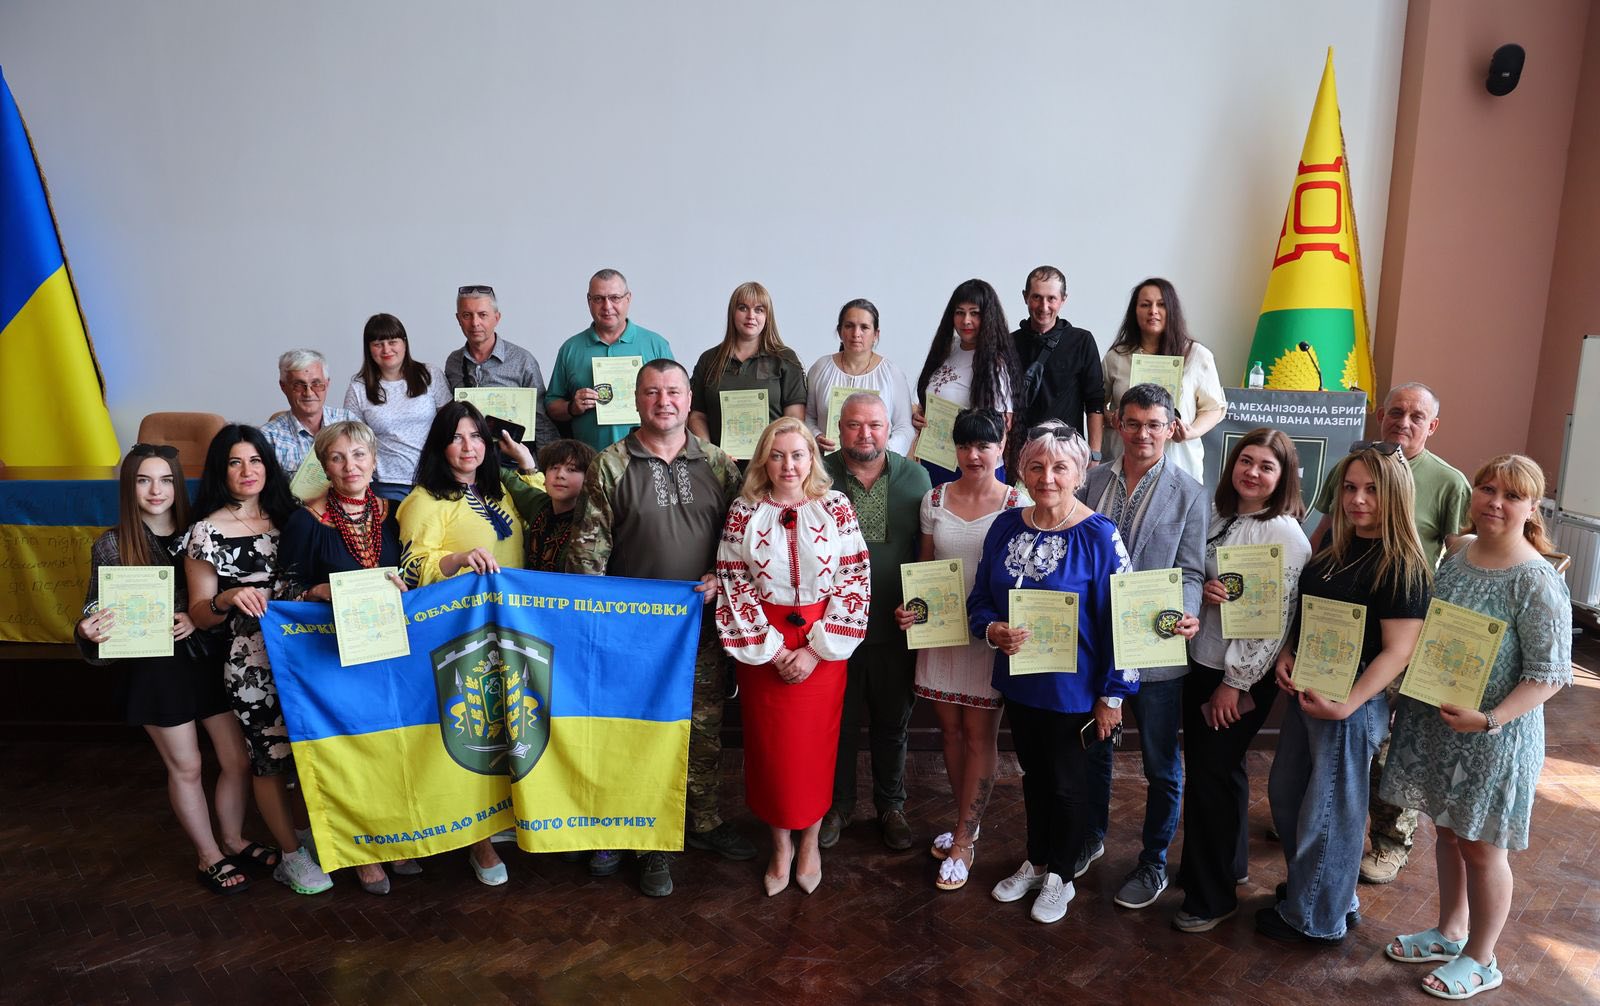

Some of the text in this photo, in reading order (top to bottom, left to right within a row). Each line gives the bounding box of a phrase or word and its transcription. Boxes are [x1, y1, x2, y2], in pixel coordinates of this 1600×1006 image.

[1224, 412, 1361, 426] ТЬМАНА ІВАНА МАЗЕПИ
[1239, 402, 1328, 415] МЕХАНІЗОВАНА
[414, 591, 504, 622] ОБЛАСНИЙ
[508, 593, 570, 609] ЦЕНТР
[574, 598, 688, 616] ПІДГОТОВКИ
[353, 824, 447, 845] ГРОМАДЯН
[450, 816, 473, 833] ДО
[567, 816, 656, 828] СПРОТИВУ
